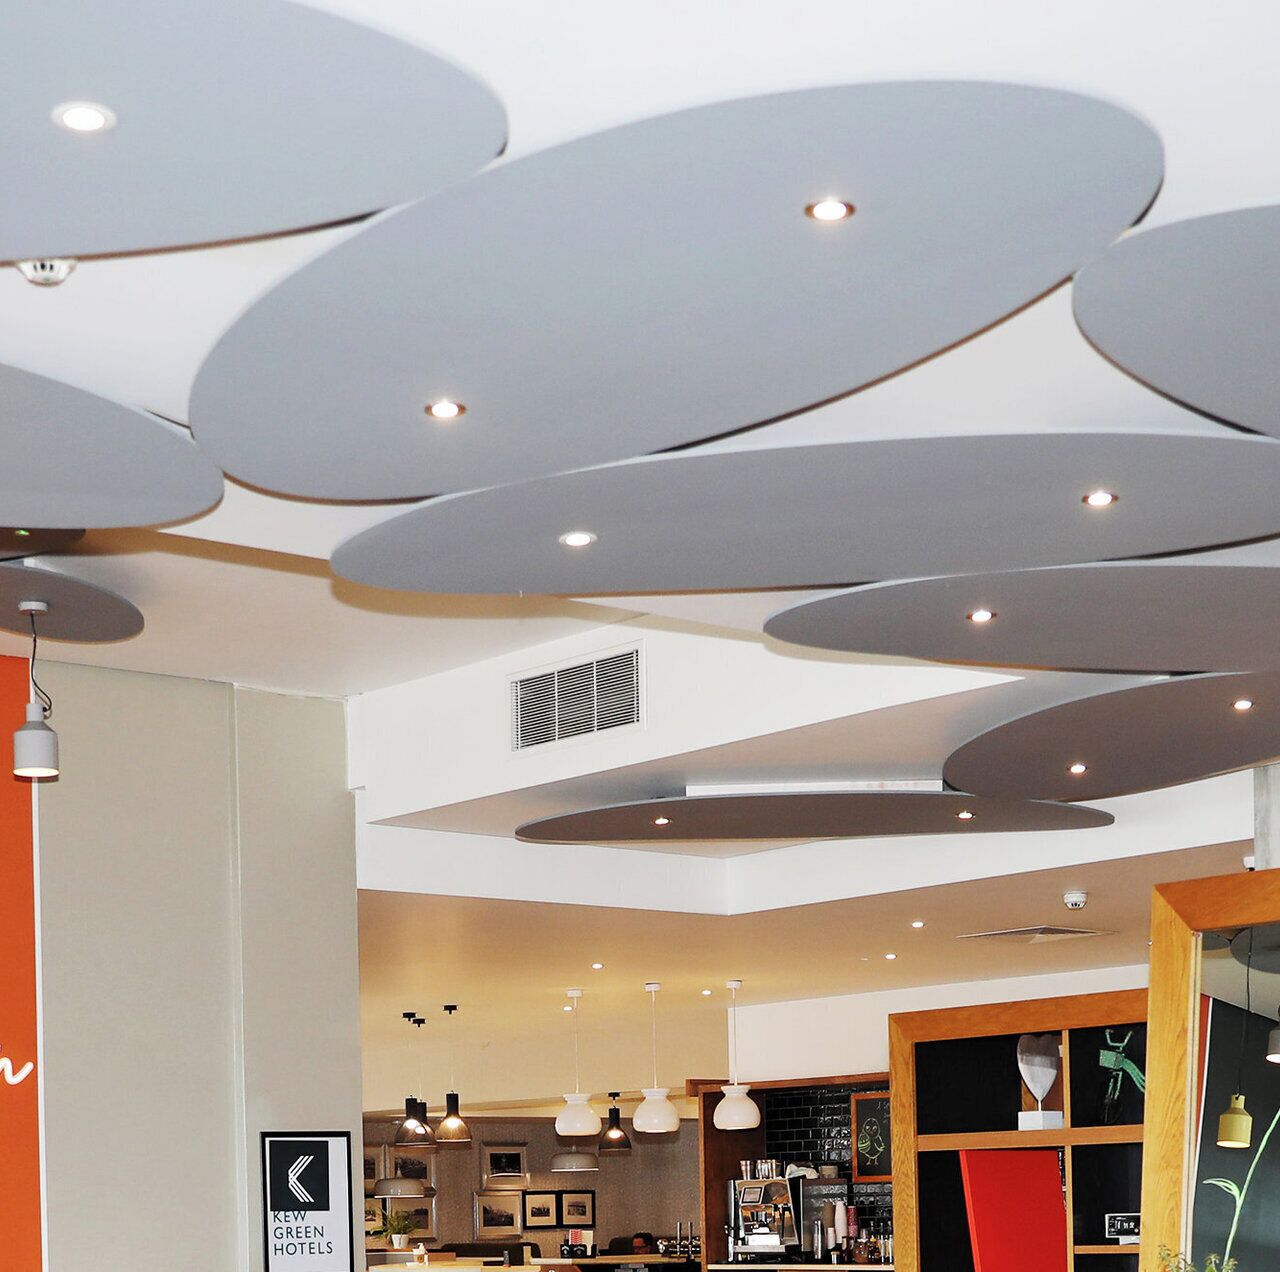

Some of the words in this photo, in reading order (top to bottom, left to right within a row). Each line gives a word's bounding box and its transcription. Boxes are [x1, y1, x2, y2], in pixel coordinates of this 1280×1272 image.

[273, 1211, 308, 1223] KEW
[273, 1226, 324, 1240] GREEN
[274, 1241, 333, 1256] HOTELS
